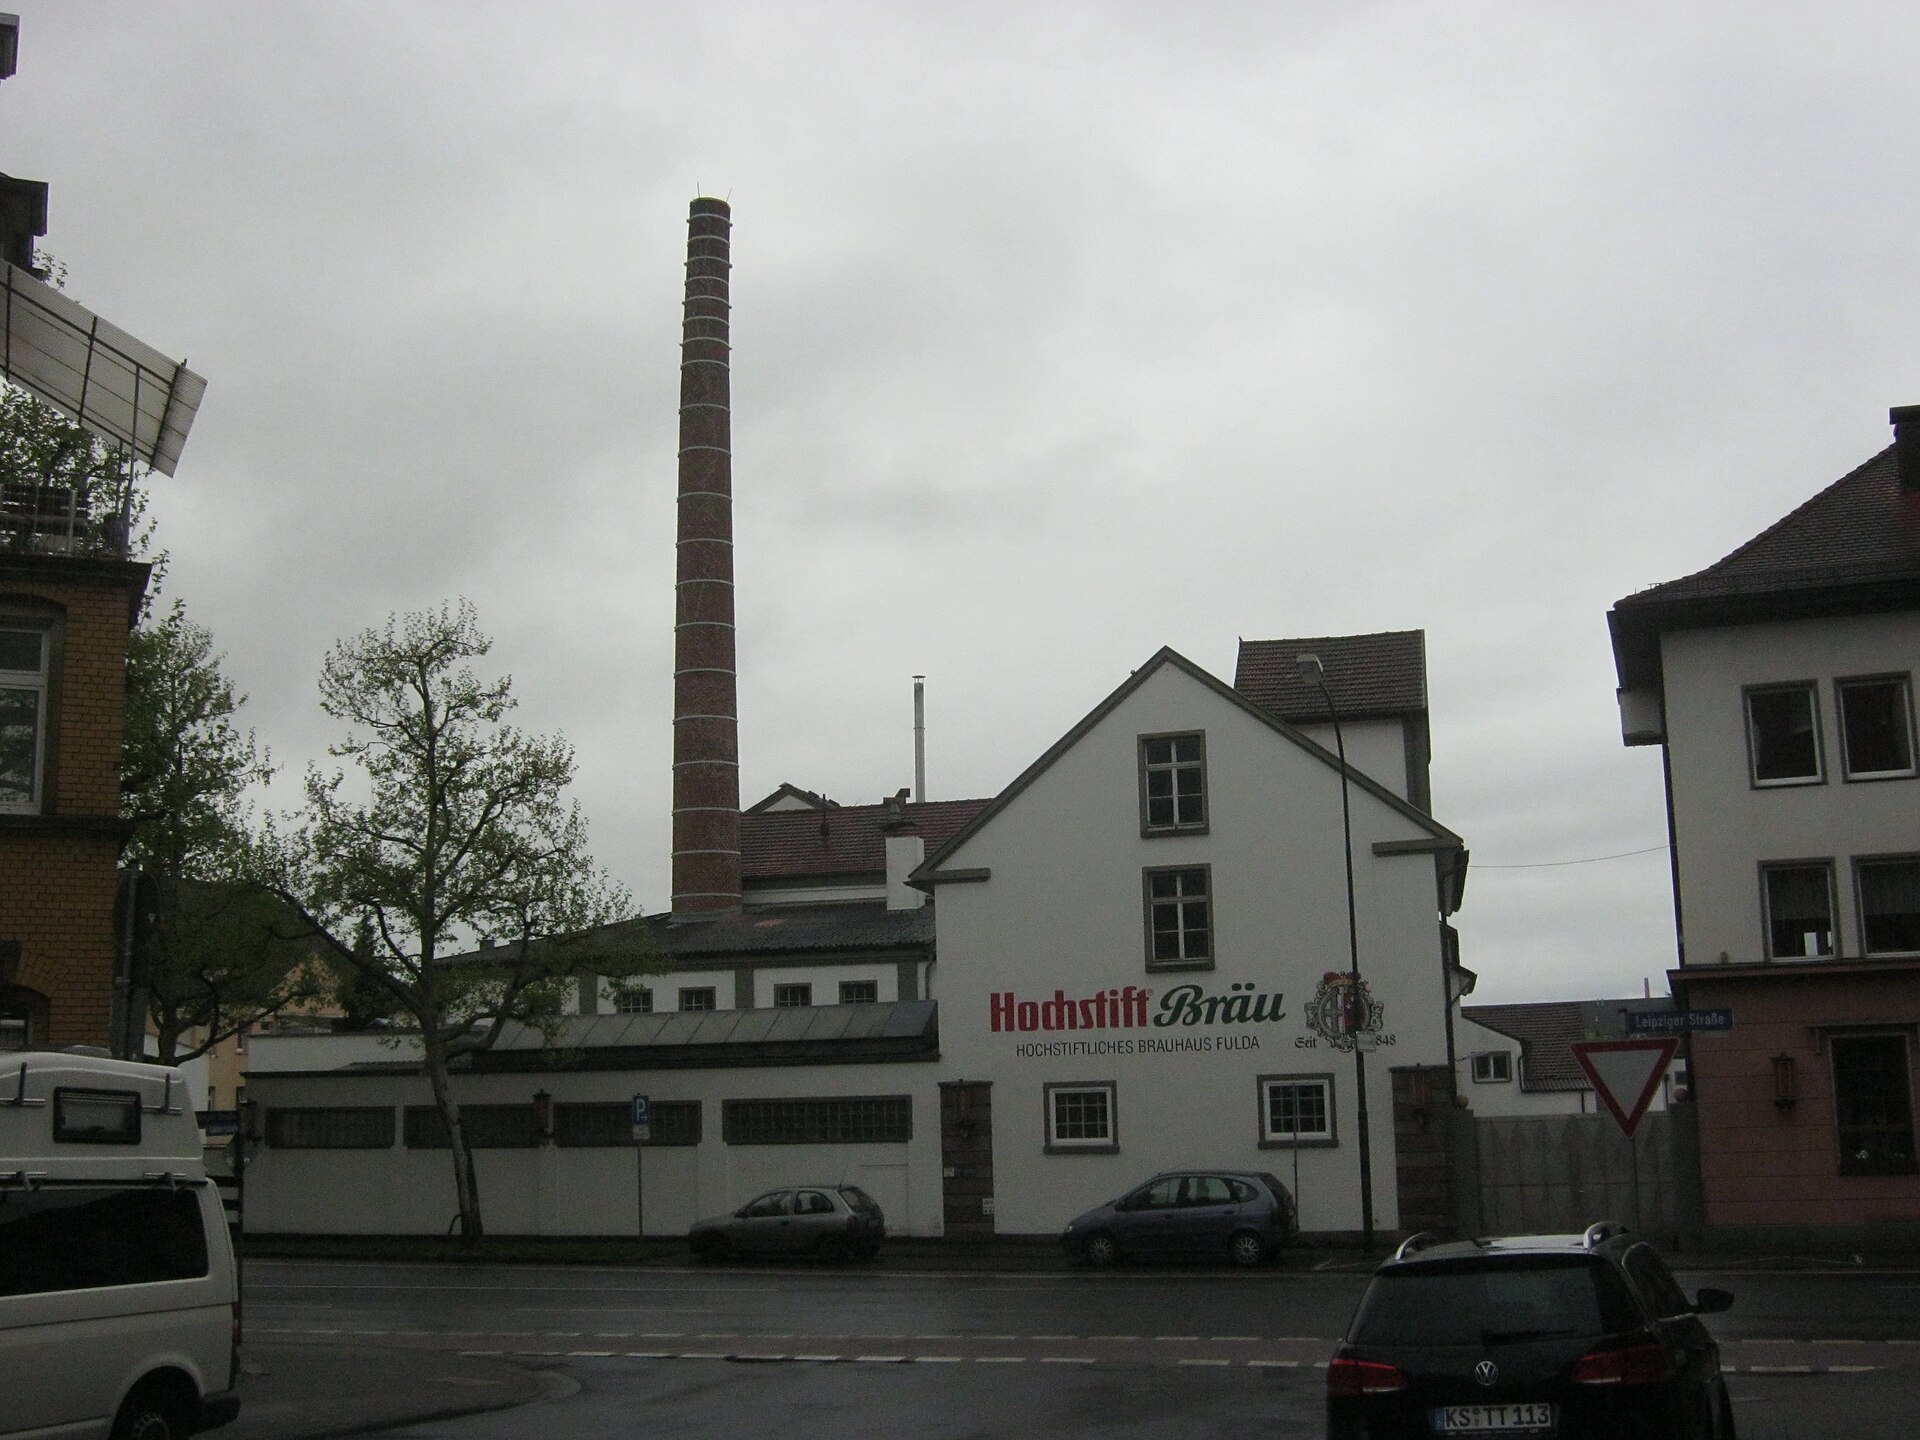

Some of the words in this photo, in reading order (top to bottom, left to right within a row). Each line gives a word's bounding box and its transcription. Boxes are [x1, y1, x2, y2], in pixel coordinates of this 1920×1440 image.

[990, 985, 1150, 1032] Hochstift
[1153, 982, 1286, 1027] Bräu
[1635, 1014, 1684, 1029] Leipziger
[1688, 1012, 1725, 1026] Straße
[1016, 1040, 1134, 1057] HOCHSTIFTLICHES
[1138, 1037, 1212, 1053] BRAUHAUS
[1216, 1035, 1260, 1050] FULDA
[1375, 1034, 1397, 1046] 848
[636, 1098, 646, 1121] P
[1446, 1407, 1471, 1428] KS
